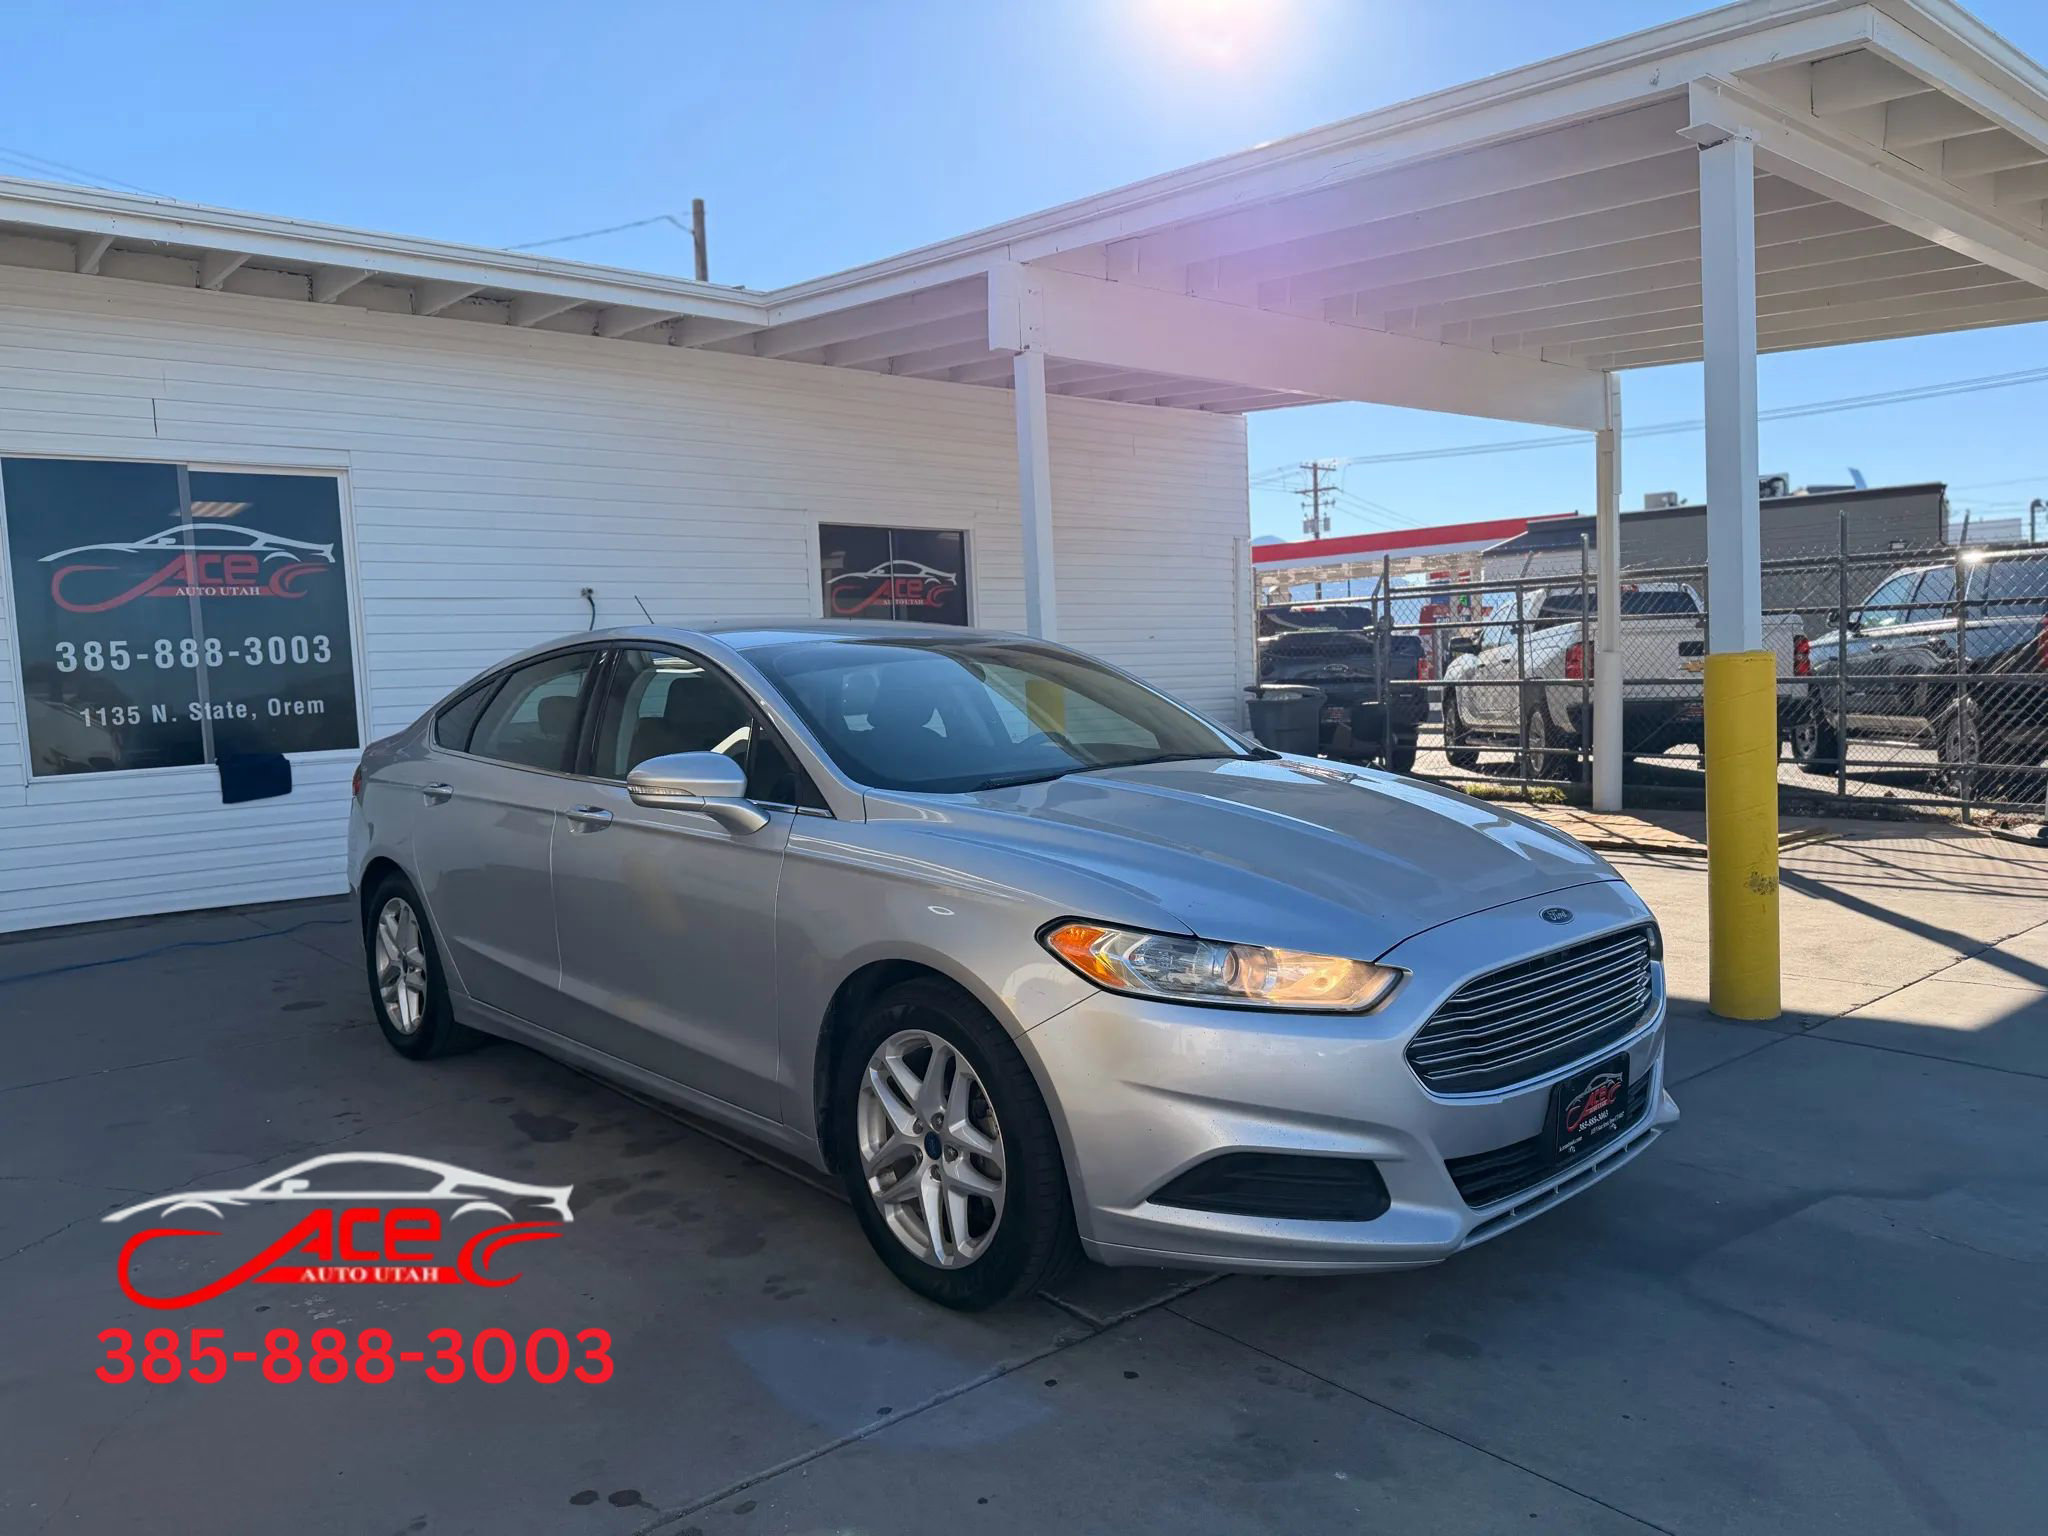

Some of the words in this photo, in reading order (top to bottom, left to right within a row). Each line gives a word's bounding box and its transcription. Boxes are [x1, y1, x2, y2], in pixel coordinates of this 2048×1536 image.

[175, 586, 217, 596] AUTO
[220, 586, 261, 596] UTAH
[55, 634, 332, 673] 385-888-3003
[79, 706, 141, 728] 1135
[152, 704, 178, 724] N.
[189, 701, 257, 722] State,
[267, 698, 325, 717] Orem
